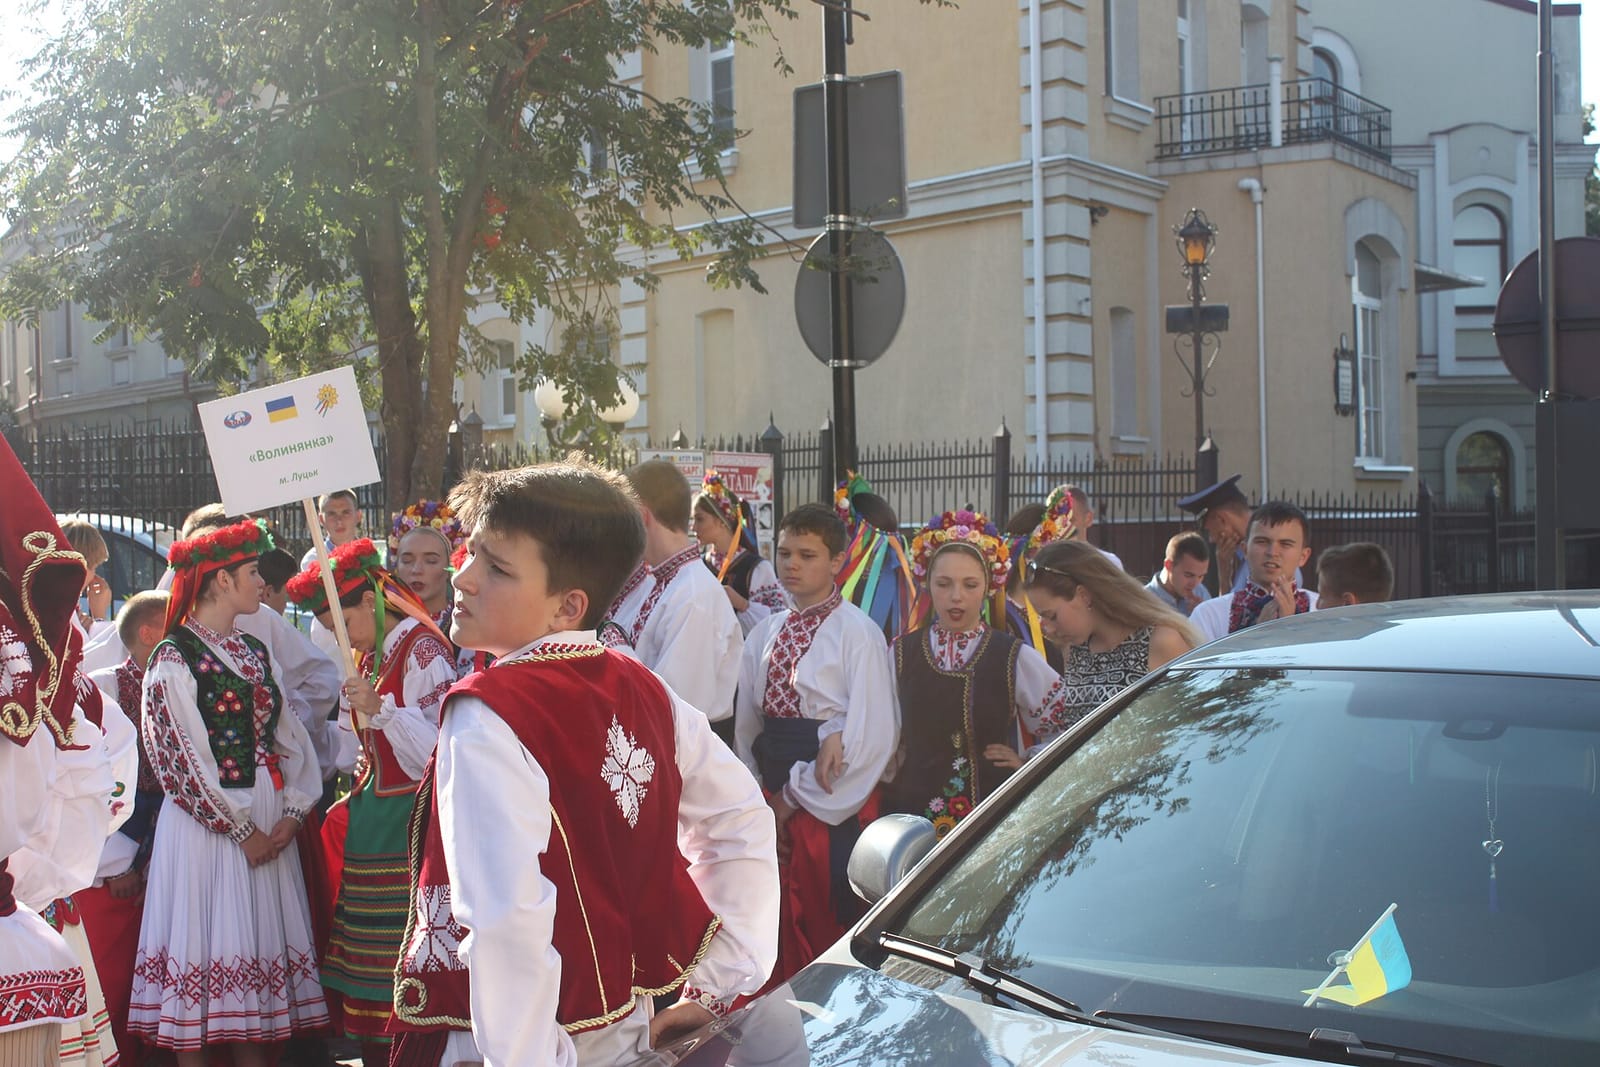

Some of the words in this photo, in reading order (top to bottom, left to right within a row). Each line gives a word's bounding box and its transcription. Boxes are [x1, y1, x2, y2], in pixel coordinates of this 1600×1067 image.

[249, 435, 334, 463] «Волинянка»
[279, 476, 290, 485] м.
[291, 469, 319, 483] Луцьк
